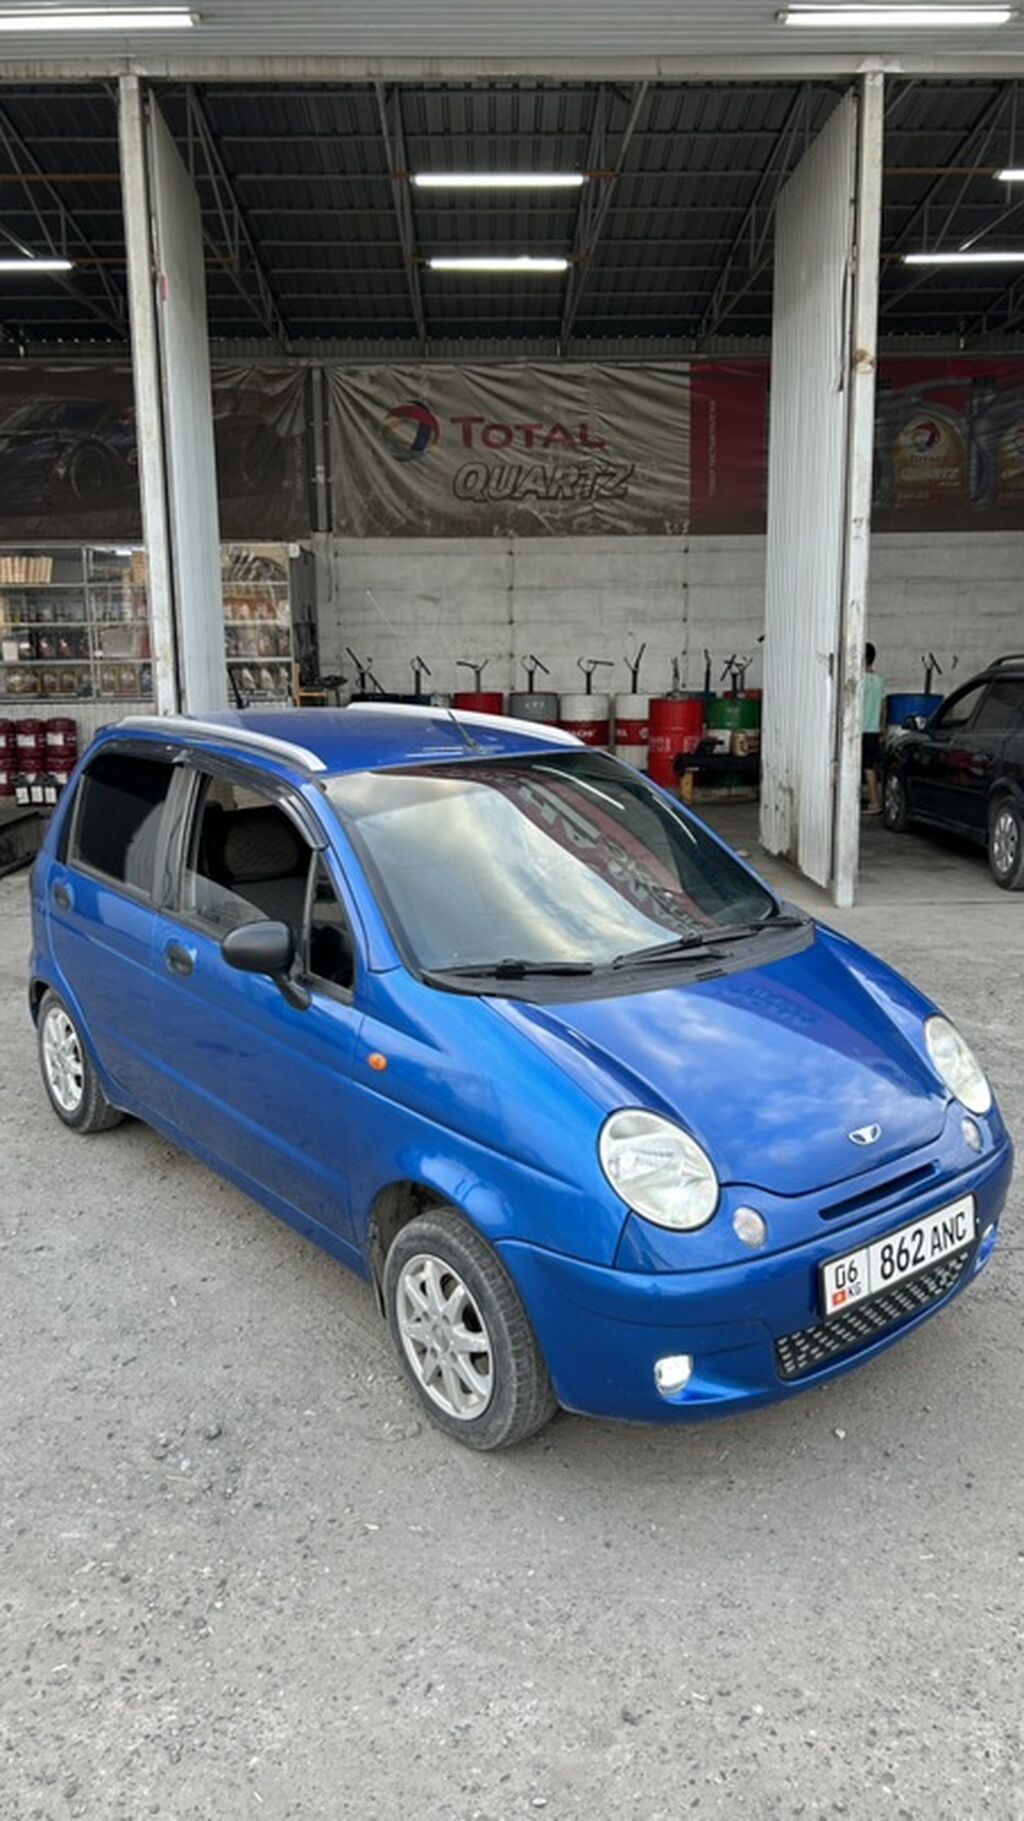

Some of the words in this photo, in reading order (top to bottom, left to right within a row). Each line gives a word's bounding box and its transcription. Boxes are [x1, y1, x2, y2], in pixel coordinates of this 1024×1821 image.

[450, 415, 606, 450] TOTAL
[452, 461, 635, 503] QUARTZ
[835, 1259, 858, 1289] 06
[880, 1228, 926, 1280] 862
[930, 1212, 967, 1257] ANC
[848, 1281, 862, 1297] KG
